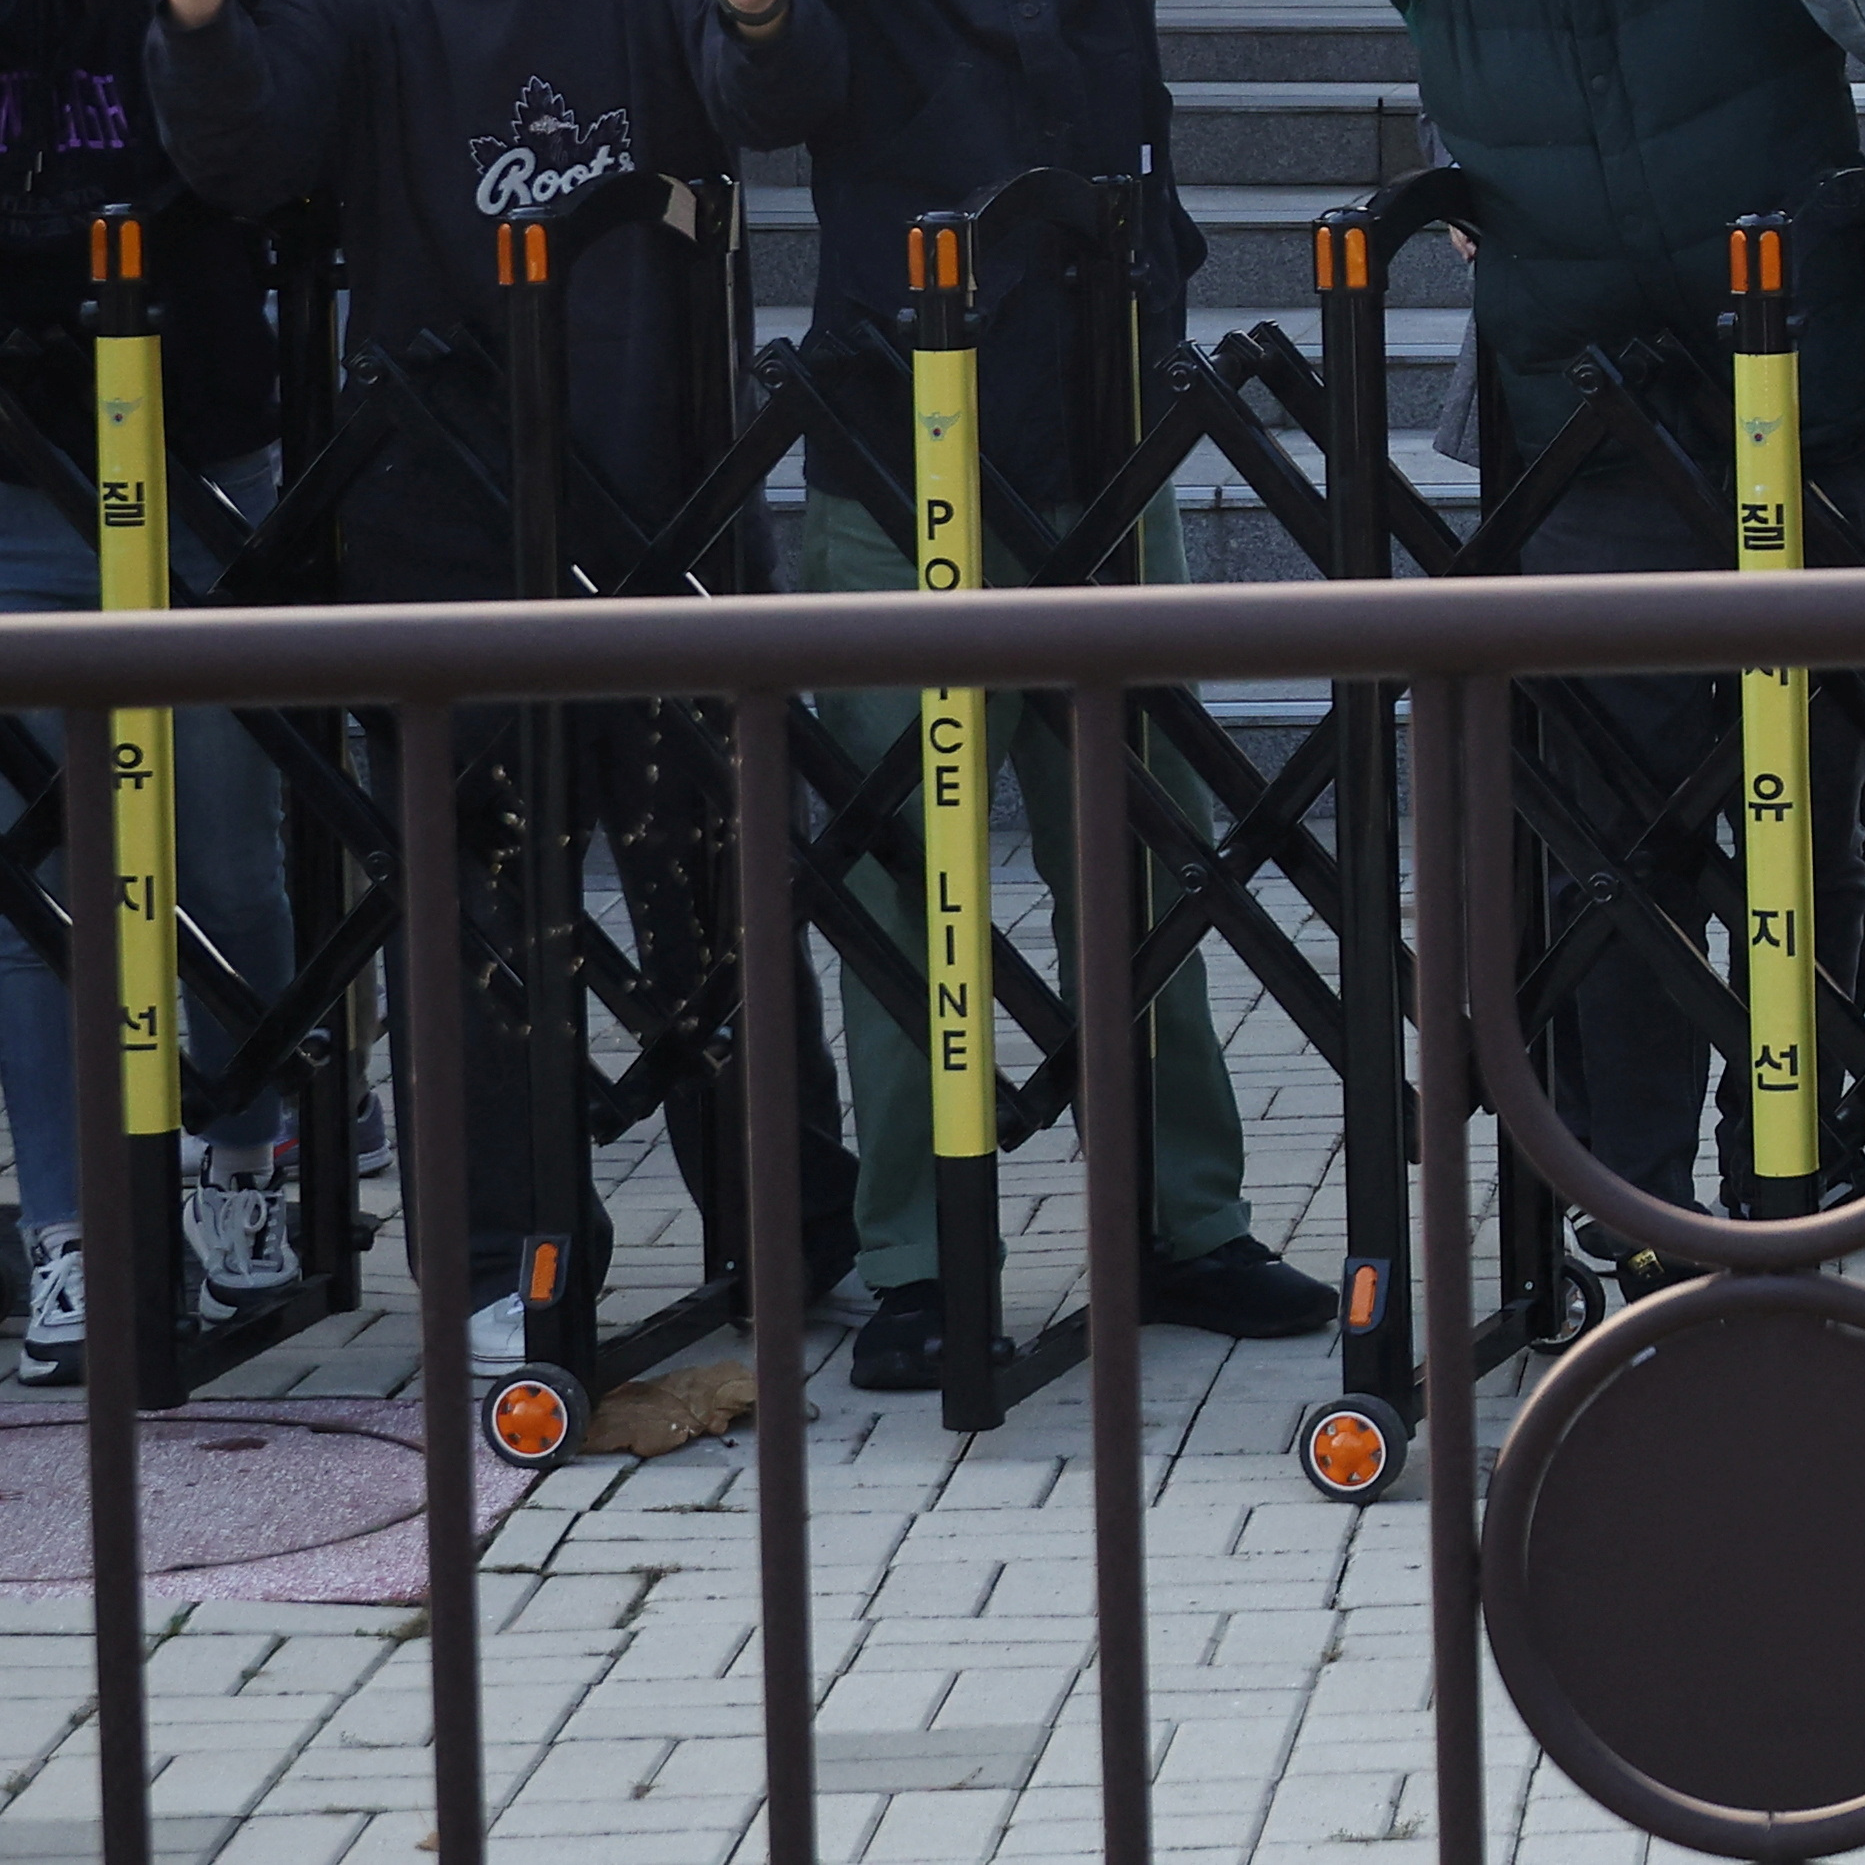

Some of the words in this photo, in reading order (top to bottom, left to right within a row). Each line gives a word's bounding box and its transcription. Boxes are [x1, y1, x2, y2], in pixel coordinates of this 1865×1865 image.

[477, 146, 634, 215] Roots
[103, 478, 157, 1051] 질유지선
[925, 499, 963, 807] POCE
[938, 871, 970, 1072] LINE
